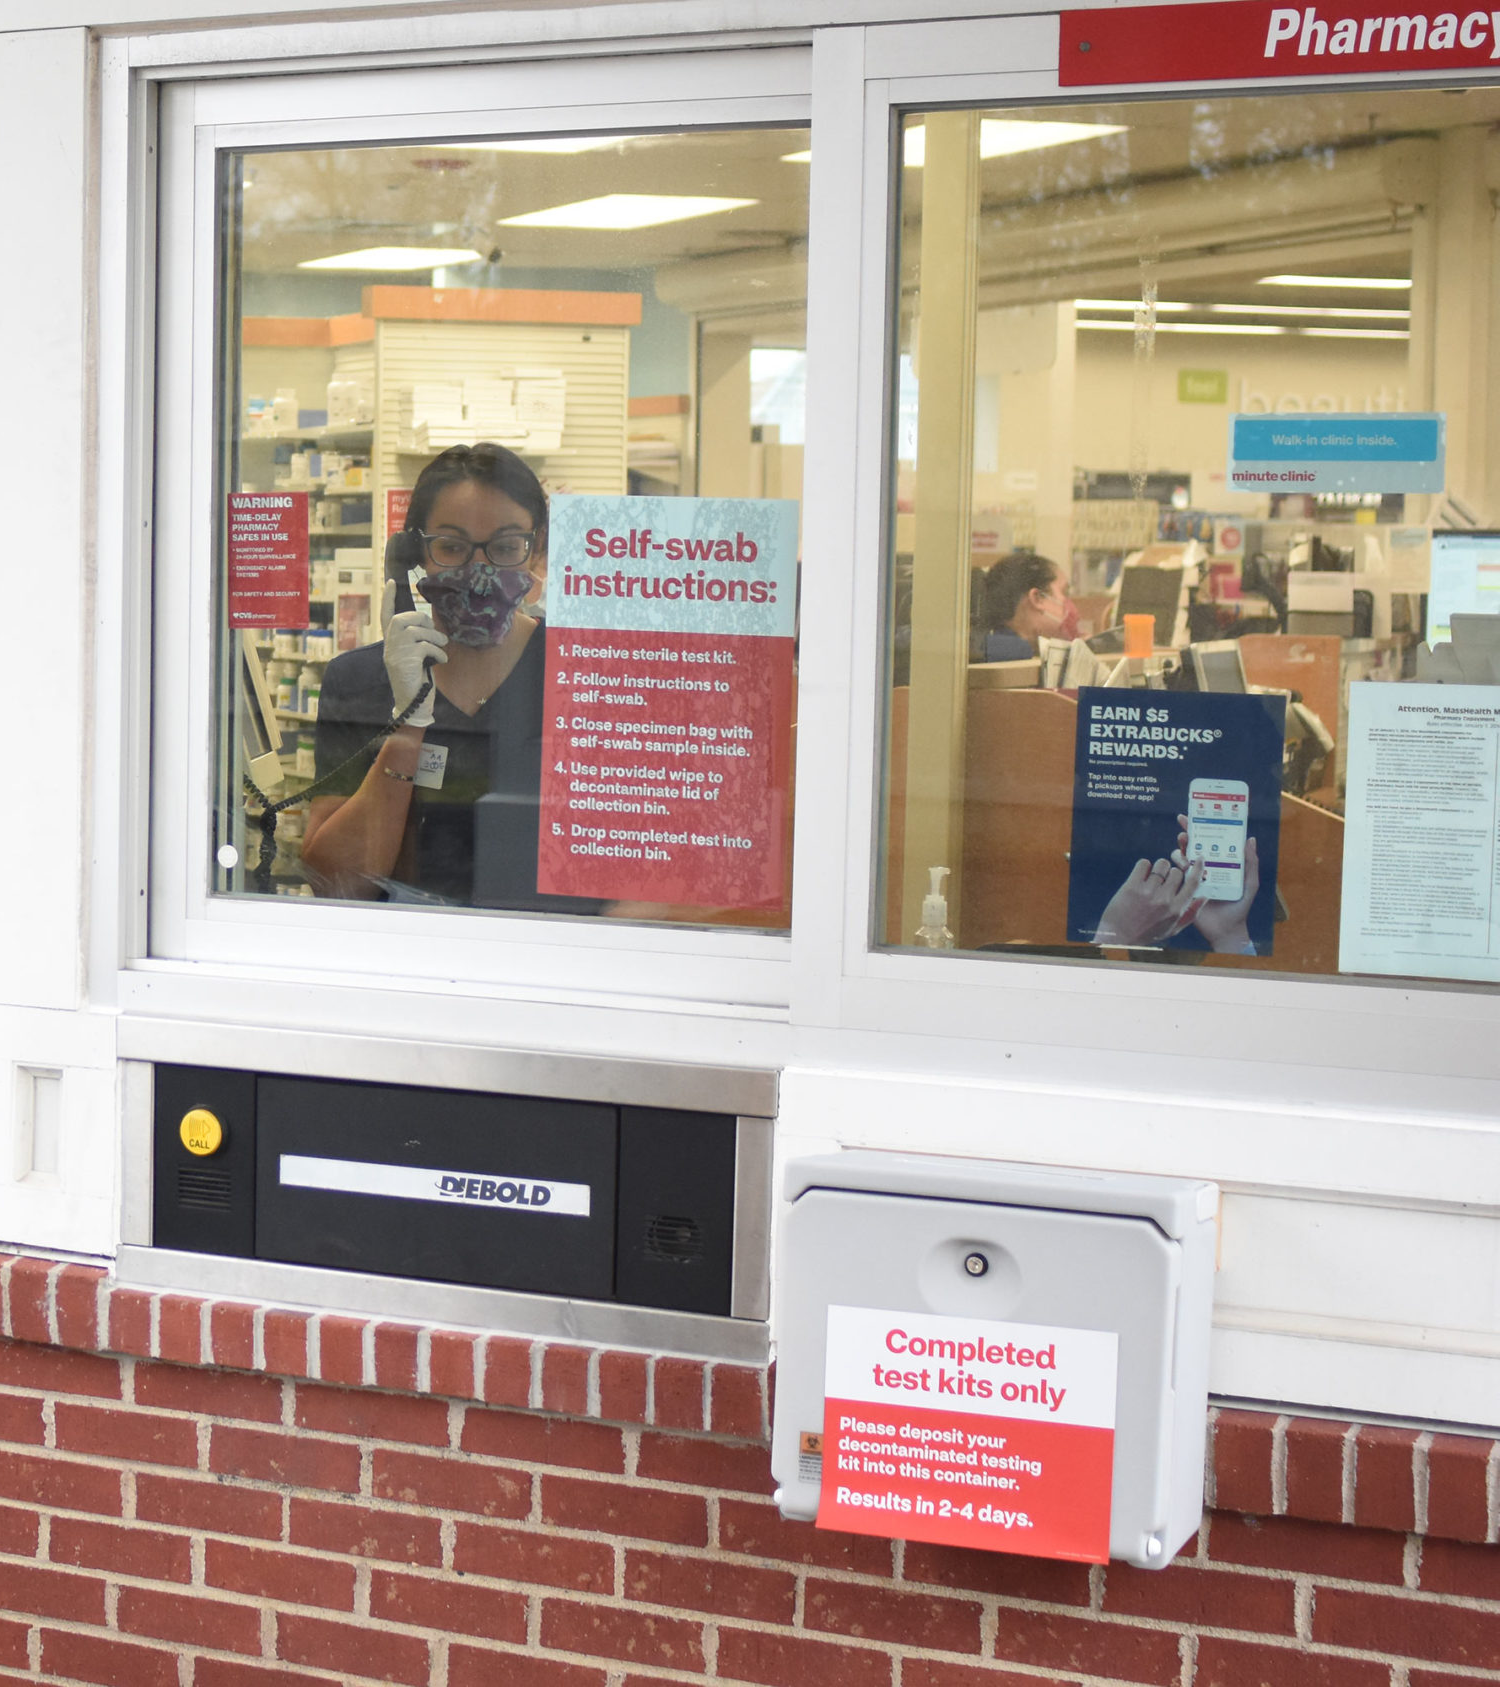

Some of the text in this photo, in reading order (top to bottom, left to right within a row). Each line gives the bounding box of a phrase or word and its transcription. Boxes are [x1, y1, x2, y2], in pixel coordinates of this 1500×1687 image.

[1272, 434, 1396, 446] Walk-in clinic inside.
[1232, 470, 1316, 482] minute clinic
[232, 497, 292, 508] WARNING
[272, 533, 289, 541] USE
[585, 528, 757, 563] Self-swab
[564, 566, 777, 603] instructions:
[558, 645, 736, 664] 1. Receive sterile test kit.
[557, 672, 730, 692] 2. Follow instructions to
[572, 690, 647, 705] self-swab.
[1091, 706, 1169, 722] EARN $5
[556, 717, 753, 740] 3. Close specimen bag with
[571, 735, 750, 757] self-swab sample inside.
[554, 761, 723, 784] 4. Use provided wipe to
[1118, 775, 1135, 783] easy
[570, 779, 719, 800] decontaminate lid of
[1087, 790, 1122, 799] download
[1138, 793, 1154, 801] app!
[1094, 782, 1123, 791] pickups
[569, 798, 670, 815] collection bin.
[552, 823, 752, 848] 5. Drop completed test into
[570, 842, 671, 860] collection bin.
[189, 1139, 210, 1149] CALL
[435, 1176, 551, 1206] DIEBOLD
[886, 1329, 1056, 1370] Completed
[873, 1364, 1066, 1411] test kits only
[840, 1416, 1006, 1450] Please deposit your
[839, 1437, 1042, 1476] decontaminated testing
[838, 1456, 859, 1470] kit
[863, 1458, 896, 1474] into
[900, 1461, 930, 1479] this
[934, 1469, 1020, 1490] container.
[836, 1486, 1033, 1528] Results in 2-4 days.
